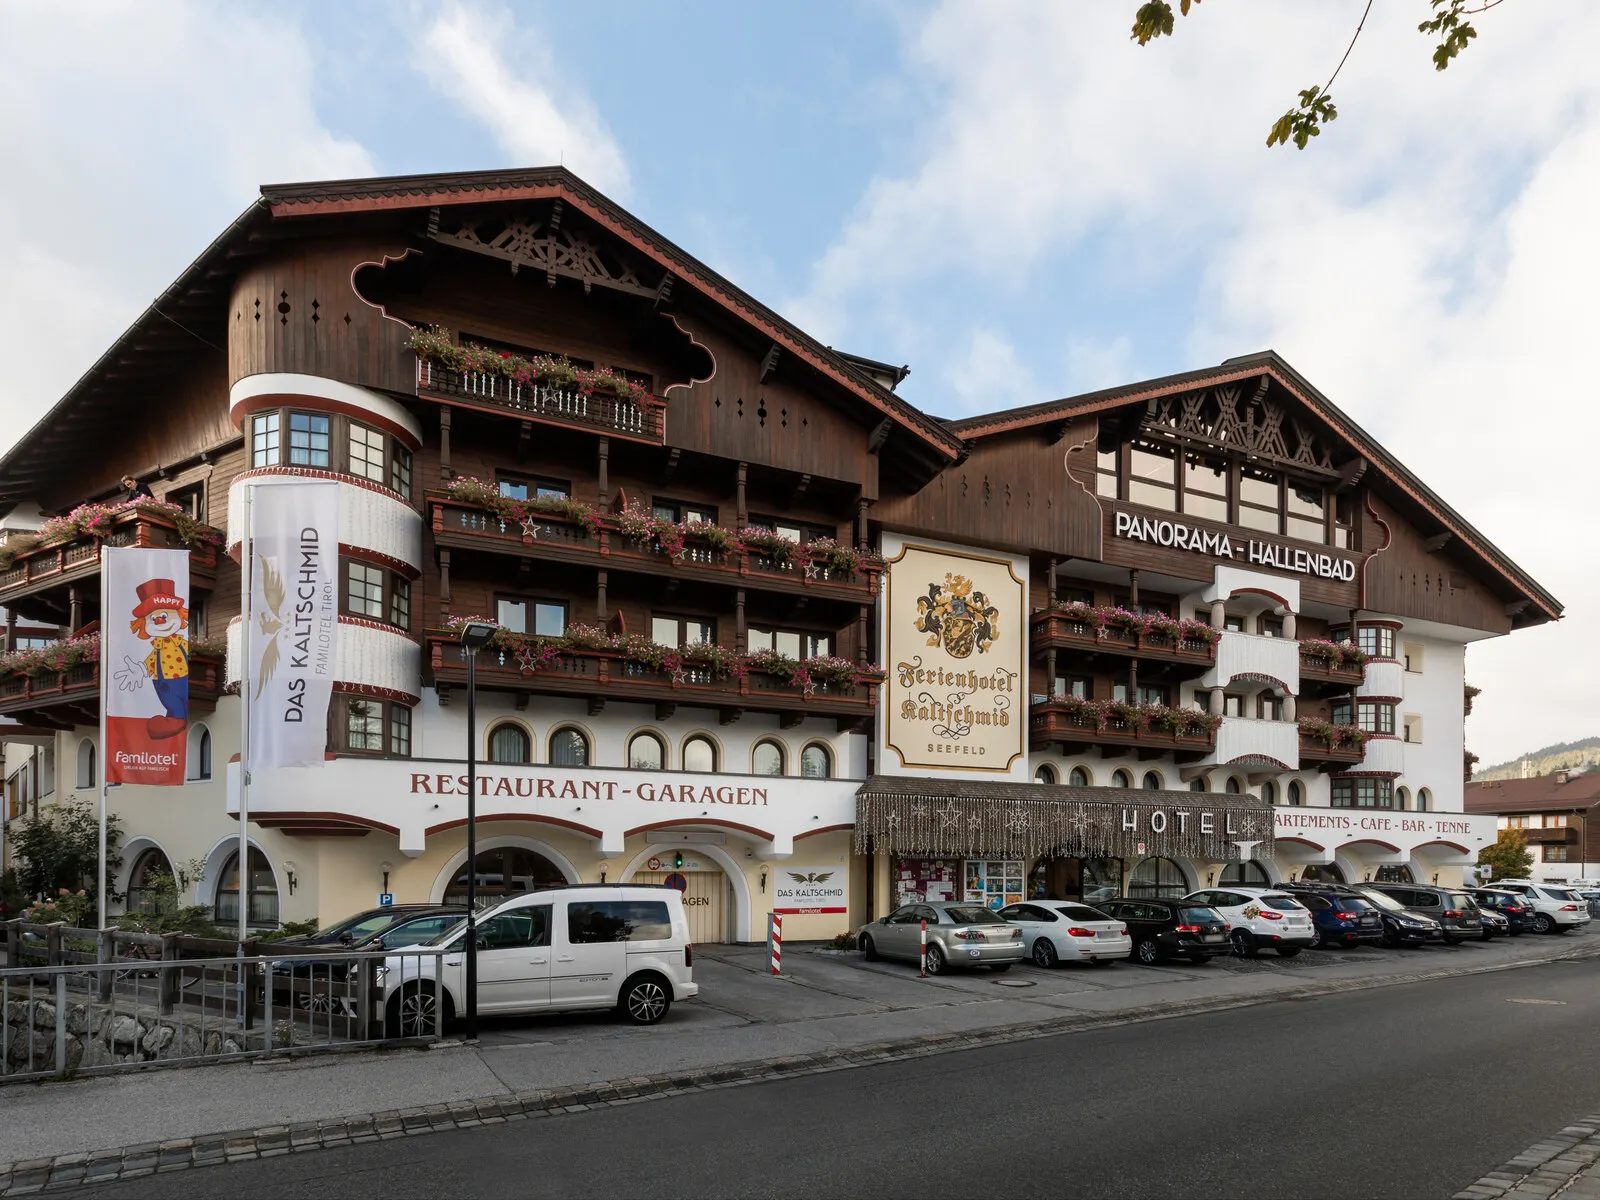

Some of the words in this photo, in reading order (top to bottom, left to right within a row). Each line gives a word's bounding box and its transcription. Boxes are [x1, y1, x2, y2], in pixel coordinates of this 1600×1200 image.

[1115, 511, 1233, 559] PANORAMA
[1249, 539, 1356, 582] HALLENBAD
[153, 597, 181, 606] HAPPY
[291, 527, 319, 668] KALTSCHMID
[322, 578, 332, 611] TIROL
[315, 613, 332, 676] FAMILOTEL
[897, 656, 1018, 694] Ferienhotel
[284, 678, 306, 722] DAS
[115, 750, 178, 766] familotel
[927, 743, 986, 755] SEEFELD
[1122, 809, 1237, 834] HOTEL
[1275, 814, 1350, 829] ARTEMENTS
[1360, 817, 1391, 831] CAFE
[1401, 819, 1425, 832] BAR
[1436, 821, 1471, 834] TENNE
[382, 894, 391, 904] P
[777, 889, 793, 897] DAS
[795, 888, 843, 897] KALTSCHMID
